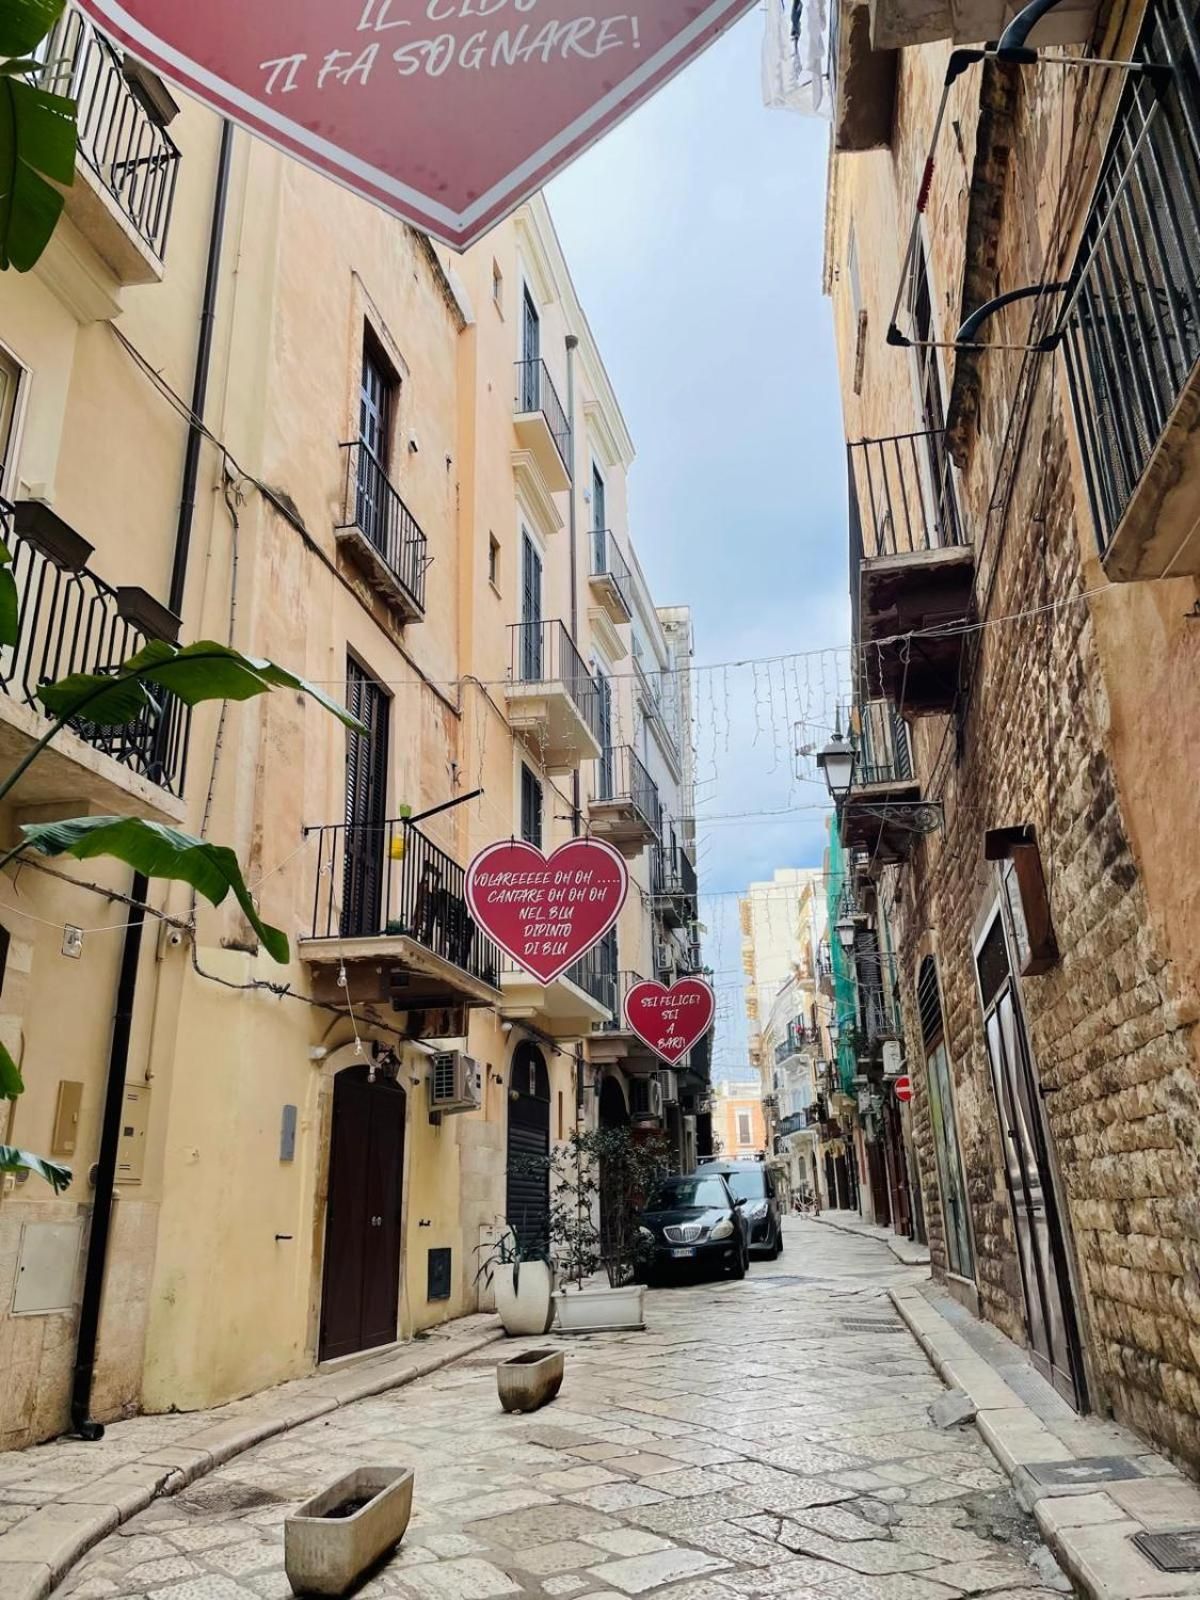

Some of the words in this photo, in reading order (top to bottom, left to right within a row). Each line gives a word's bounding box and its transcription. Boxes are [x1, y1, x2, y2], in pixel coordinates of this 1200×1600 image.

[356, 0, 411, 31] IL
[260, 54, 306, 94] TI
[317, 43, 379, 88] FA
[393, 15, 641, 77] SOGNARE!
[474, 872, 550, 887] VOLAREEEEE
[554, 870, 573, 885] OH
[575, 870, 593, 885] OH
[487, 889, 545, 903] CANTARE
[547, 888, 566, 902] OH
[568, 888, 586, 901] OH
[588, 887, 607, 901] OH
[519, 907, 545, 920] NEL
[549, 906, 574, 919] BLU
[524, 923, 572, 937] DIPINTO
[524, 941, 541, 955] DI
[542, 941, 568, 955] BLU
[641, 996, 658, 1007] SEI
[659, 995, 701, 1006] FELICE?
[661, 1009, 679, 1020] SEI
[666, 1022, 676, 1035] A
